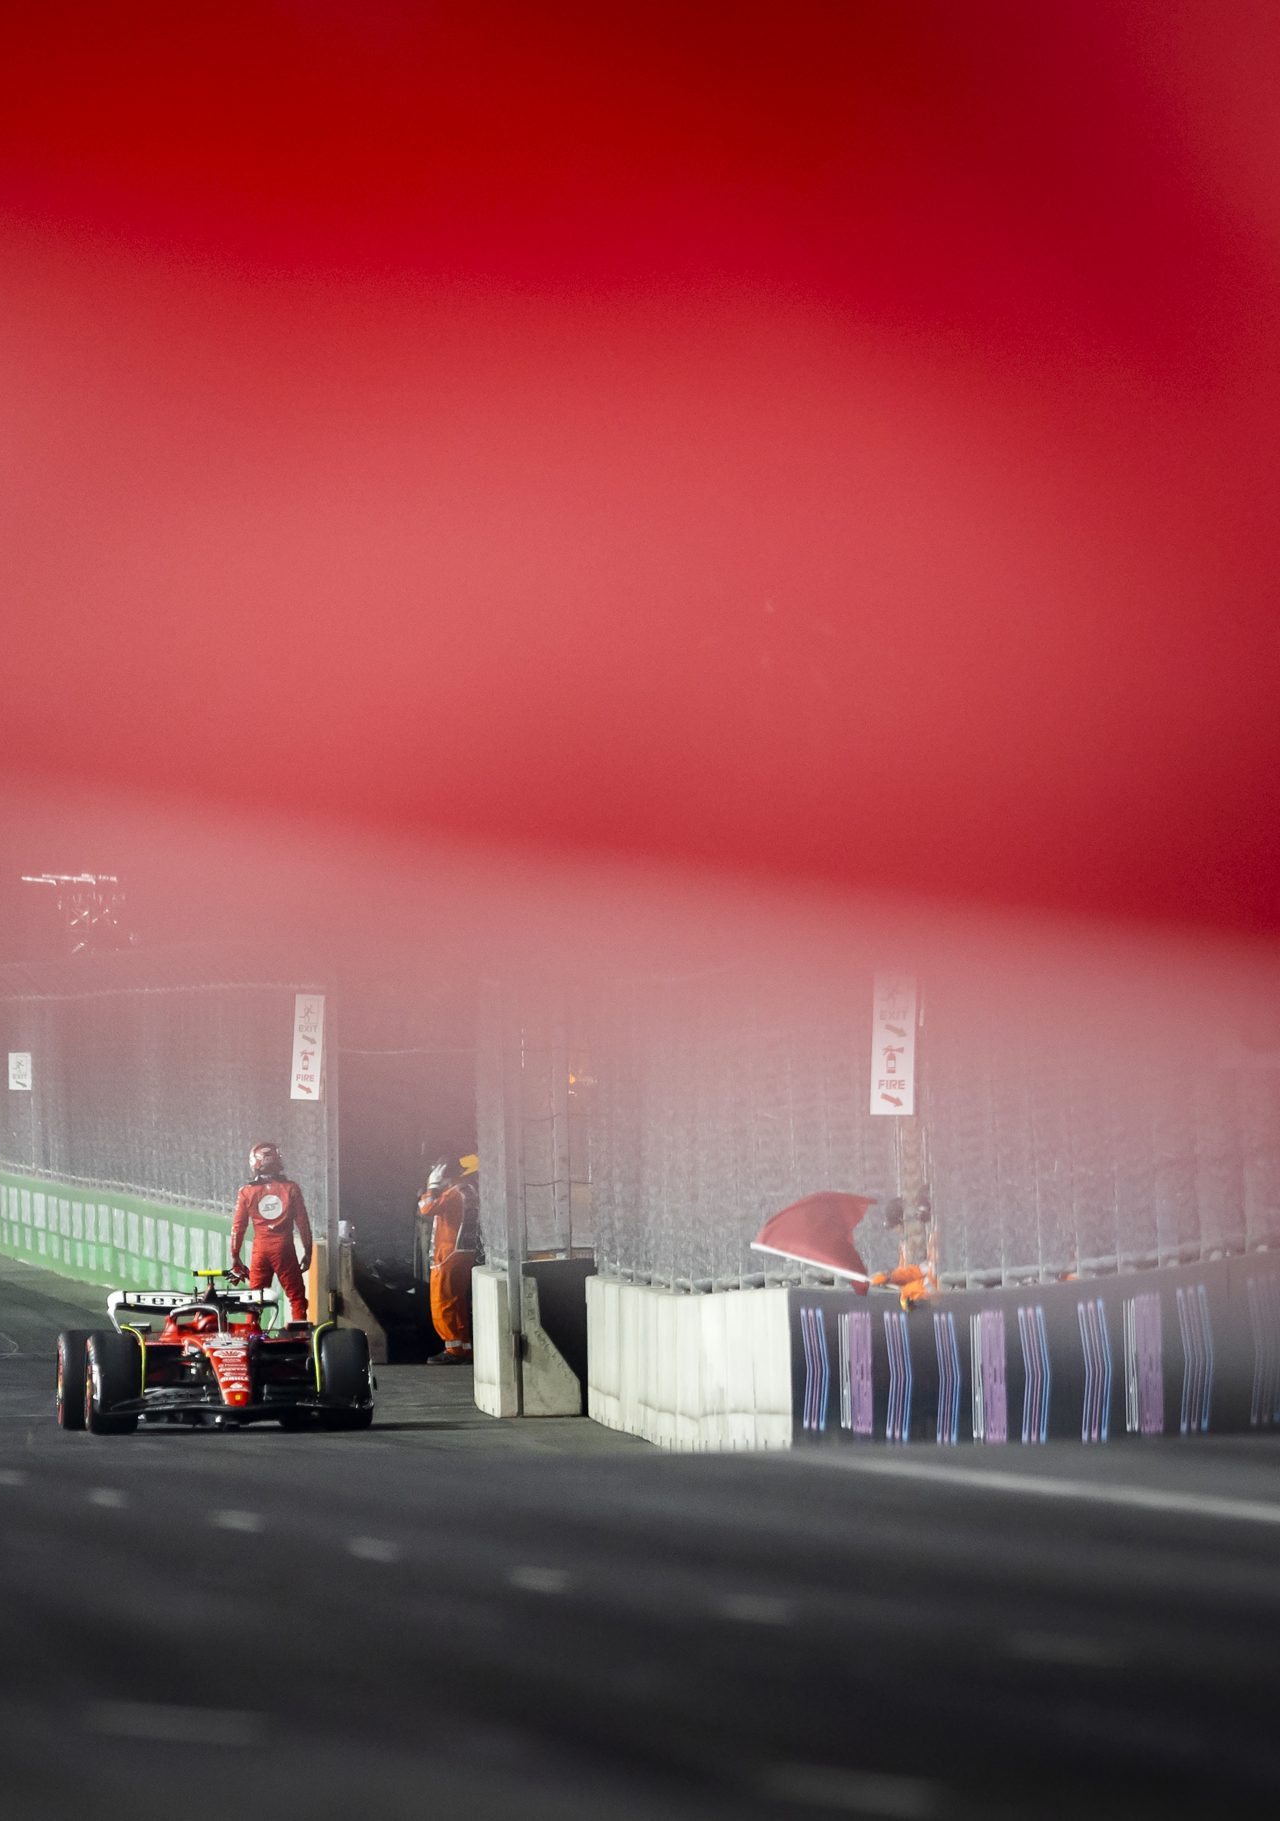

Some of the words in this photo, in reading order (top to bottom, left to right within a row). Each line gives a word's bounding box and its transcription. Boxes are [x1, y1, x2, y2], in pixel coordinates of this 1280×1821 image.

[878, 1009, 907, 1020] EXIT
[298, 1025, 318, 1033] EXIT
[296, 1074, 315, 1082] FIRE
[877, 1079, 906, 1090] FIRE
